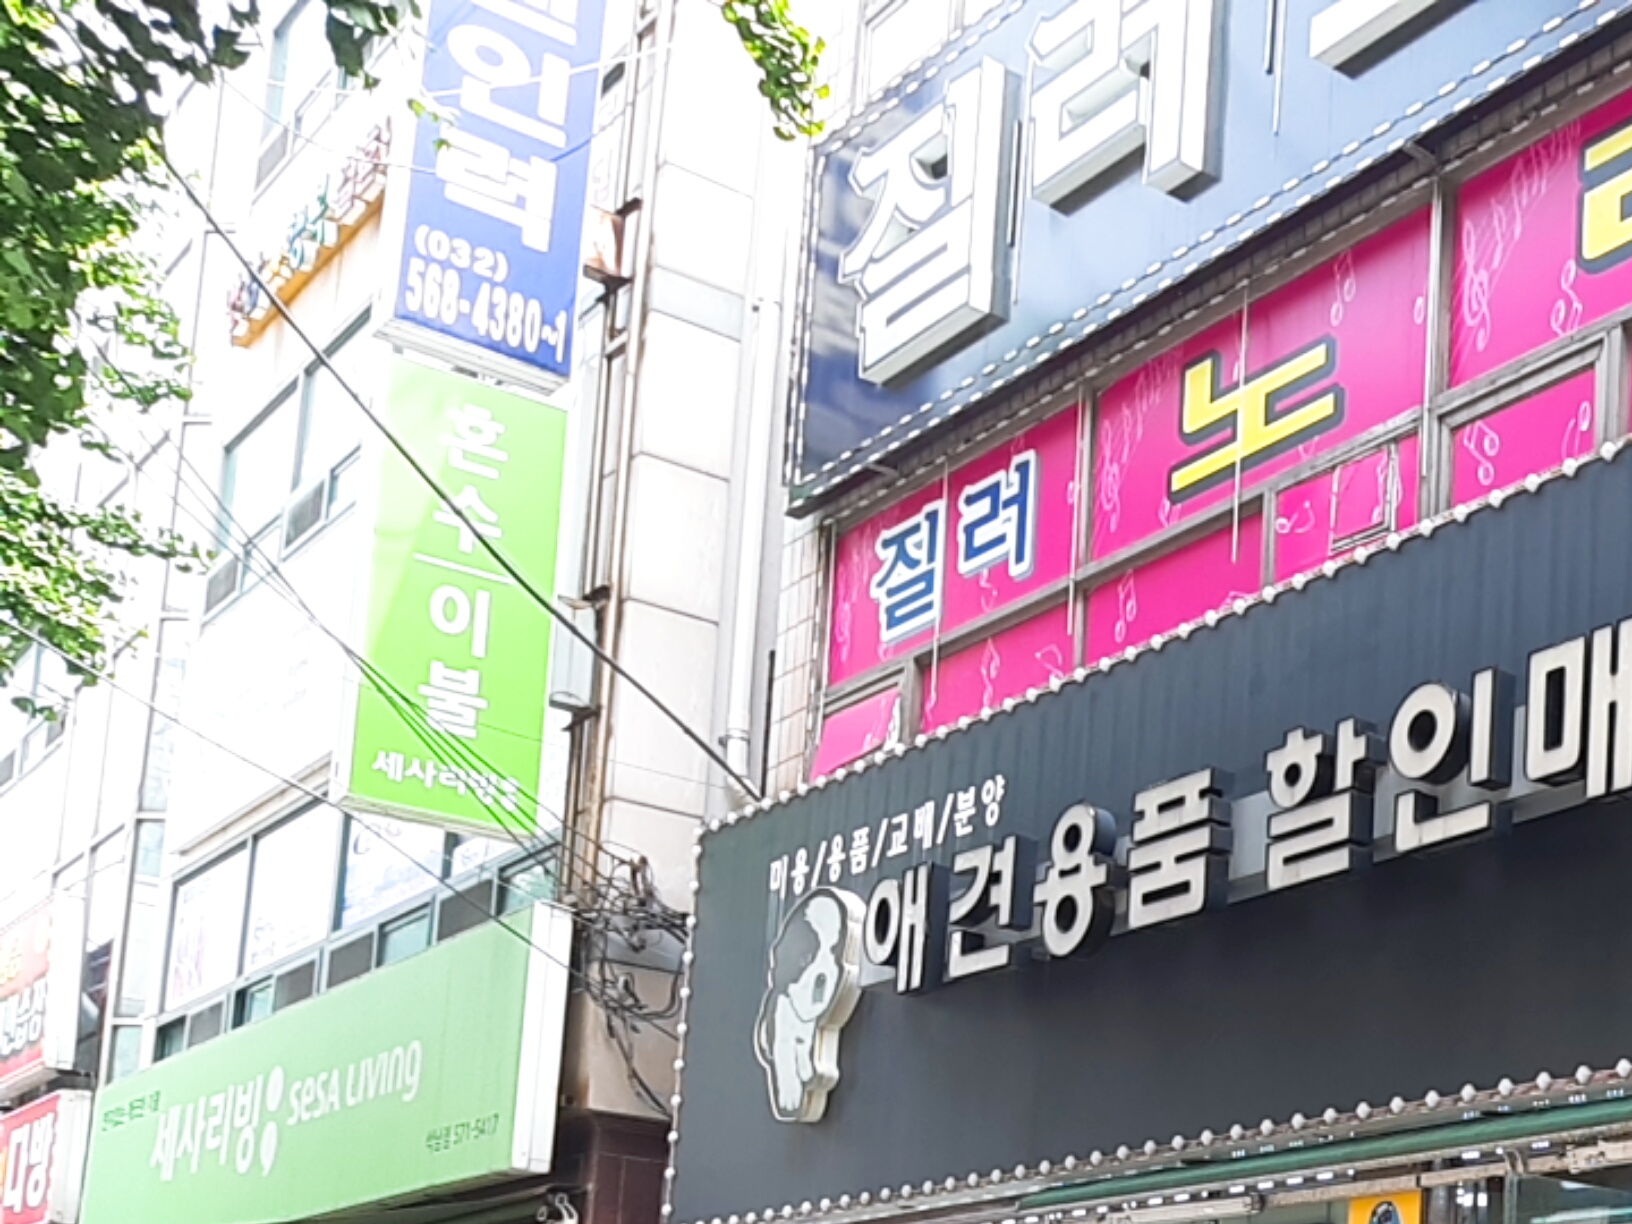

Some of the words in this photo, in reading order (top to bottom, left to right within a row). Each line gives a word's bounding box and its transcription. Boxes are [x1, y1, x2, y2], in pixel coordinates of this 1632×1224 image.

[414, 224, 509, 283] (032)
[433, 403, 509, 555] 혼수
[870, 449, 1037, 644] 질러
[417, 584, 490, 740] 이불
[864, 768, 1230, 994] 애견용품
[151, 1074, 264, 1182] 세사리빙
